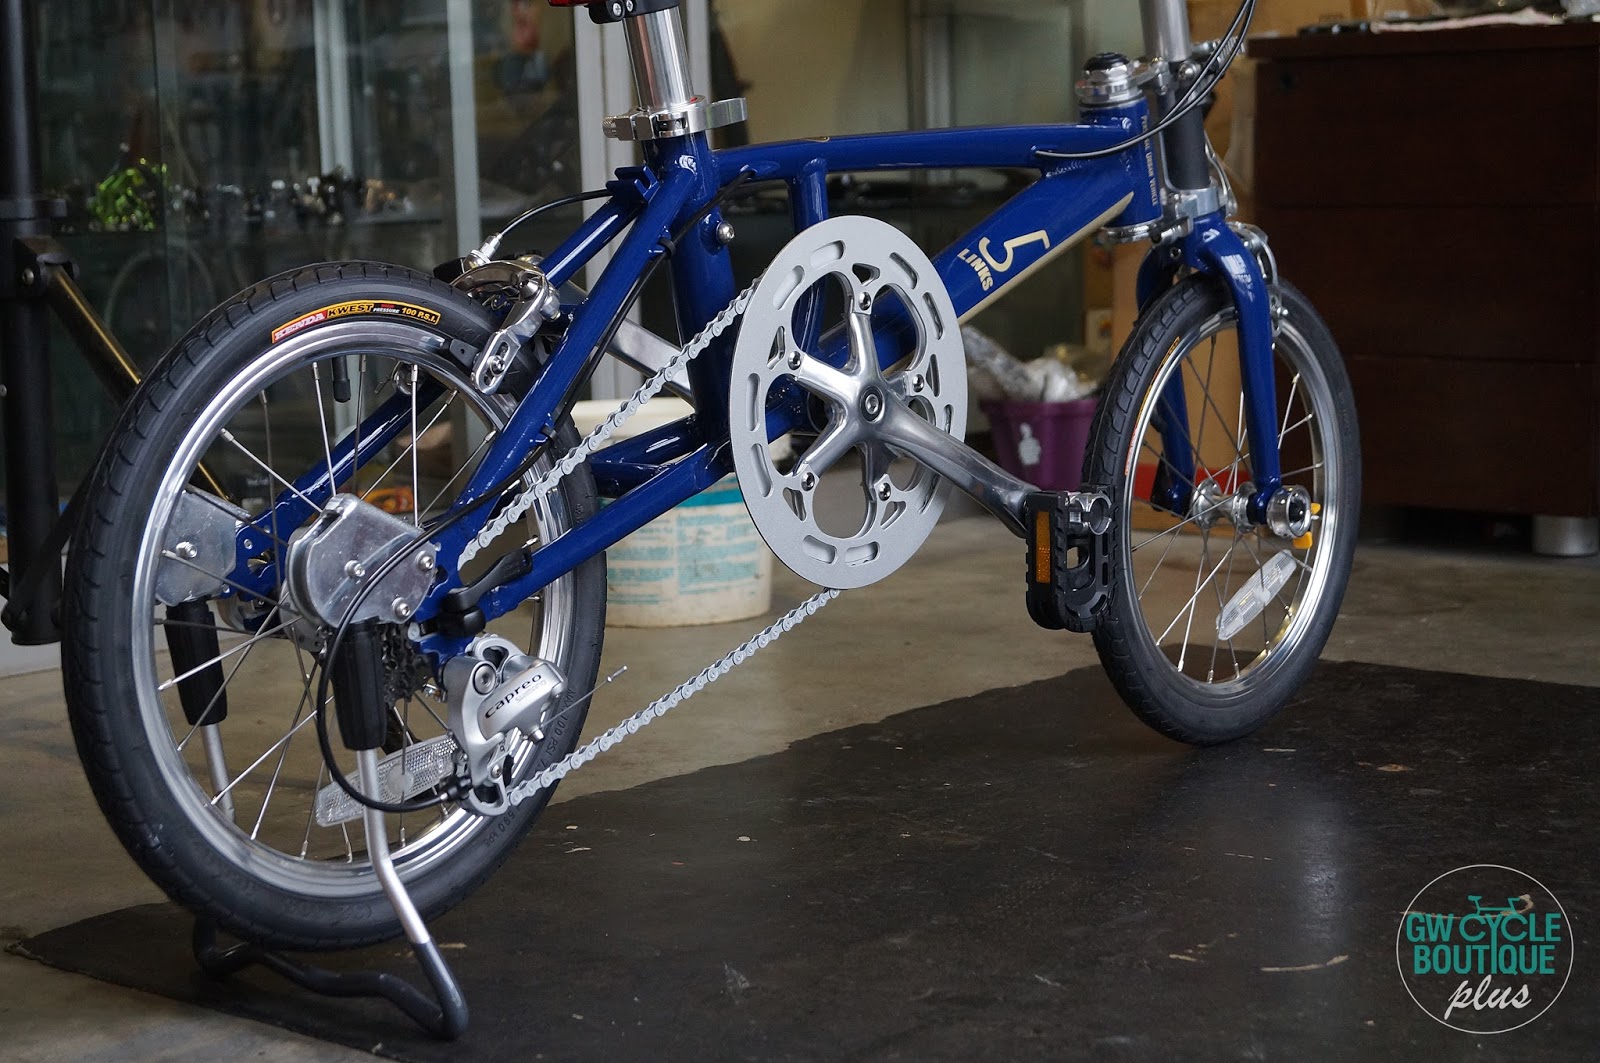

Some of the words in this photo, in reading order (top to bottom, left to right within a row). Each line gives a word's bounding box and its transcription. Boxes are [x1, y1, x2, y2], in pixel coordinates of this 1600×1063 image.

[978, 229, 1051, 272] 5
[957, 248, 994, 292] LINKS
[274, 313, 325, 341] KENDA
[327, 303, 374, 319] KWEST
[401, 307, 417, 316] 100
[417, 311, 436, 323] P.S.I.
[554, 713, 568, 736] 100
[545, 737, 558, 756] PSI
